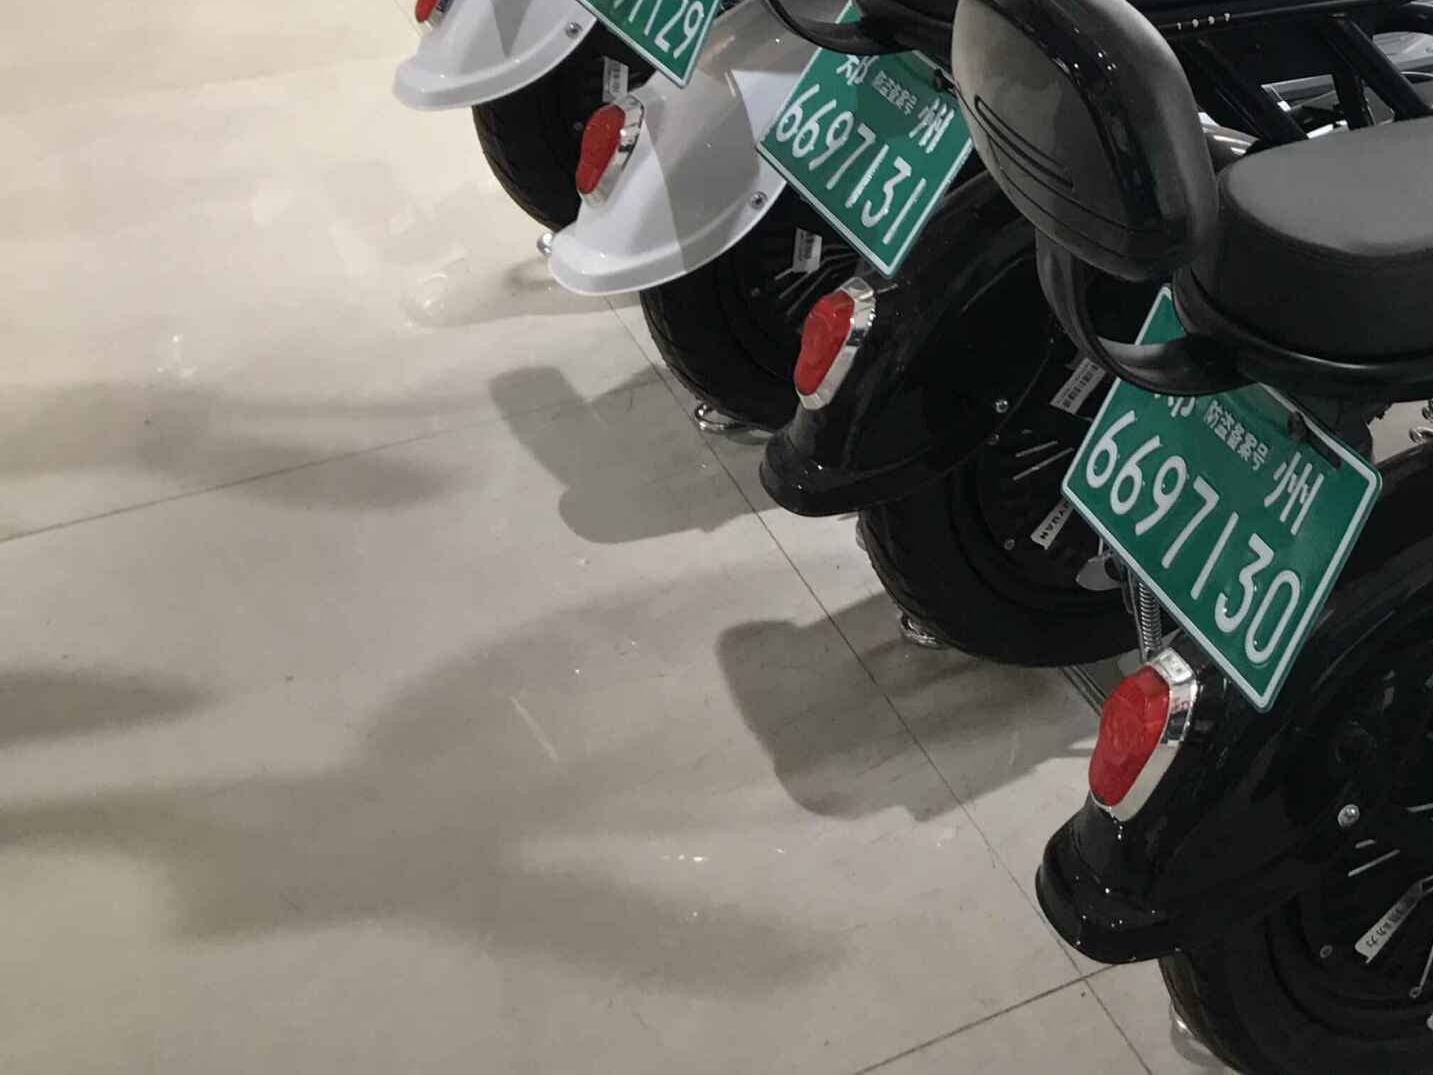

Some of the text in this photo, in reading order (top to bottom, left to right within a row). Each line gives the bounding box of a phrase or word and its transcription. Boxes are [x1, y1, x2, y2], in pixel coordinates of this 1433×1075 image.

[775, 83, 928, 246] 6697131
[908, 97, 955, 155] 州
[1085, 409, 1301, 665] 6697130
[1202, 399, 1325, 536] 防盗备案号 州
